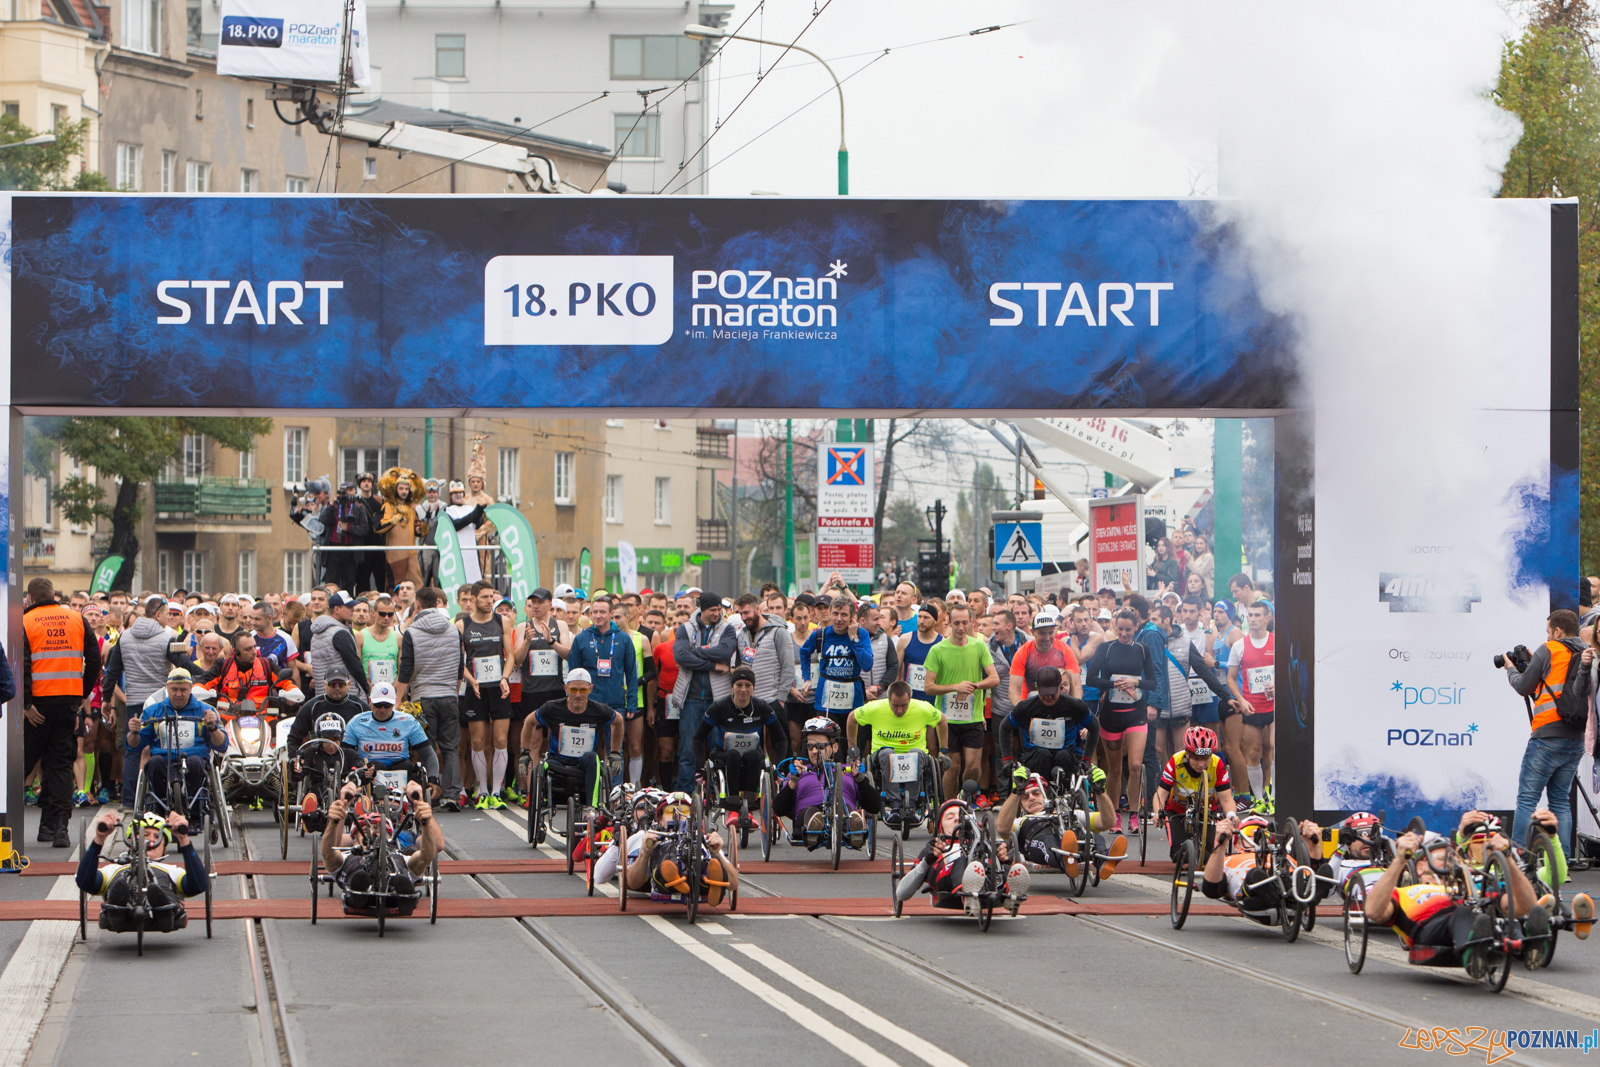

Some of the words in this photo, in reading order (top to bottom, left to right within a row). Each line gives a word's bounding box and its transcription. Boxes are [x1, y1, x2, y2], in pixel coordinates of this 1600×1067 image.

[228, 24, 245, 38] 18.
[248, 25, 279, 39] PKO
[288, 33, 337, 45] maraton
[156, 280, 344, 325] START
[503, 283, 558, 318] 18.
[568, 282, 657, 317] PKO
[989, 282, 1174, 327] START
[692, 298, 837, 327] maraton
[712, 329, 759, 341] Macieja
[763, 329, 838, 340] Frankiewicza
[1111, 424, 1128, 443] 16
[1042, 417, 1134, 461] szkiewicz.pl
[821, 518, 861, 526] Podstrefa
[863, 518, 870, 526] A
[1103, 565, 1121, 585] PONIŻEJ
[34, 614, 70, 622] OCHRONA
[46, 628, 66, 637] 028
[540, 658, 551, 666] 94
[380, 668, 388, 676] 41
[484, 664, 493, 673] 30
[831, 691, 849, 699] 7231
[950, 701, 969, 710] 7378
[877, 730, 911, 739] Achilles
[1041, 729, 1057, 738] 201
[572, 737, 584, 746] 121
[374, 743, 402, 752] LOTOS
[898, 763, 910, 771] 166
